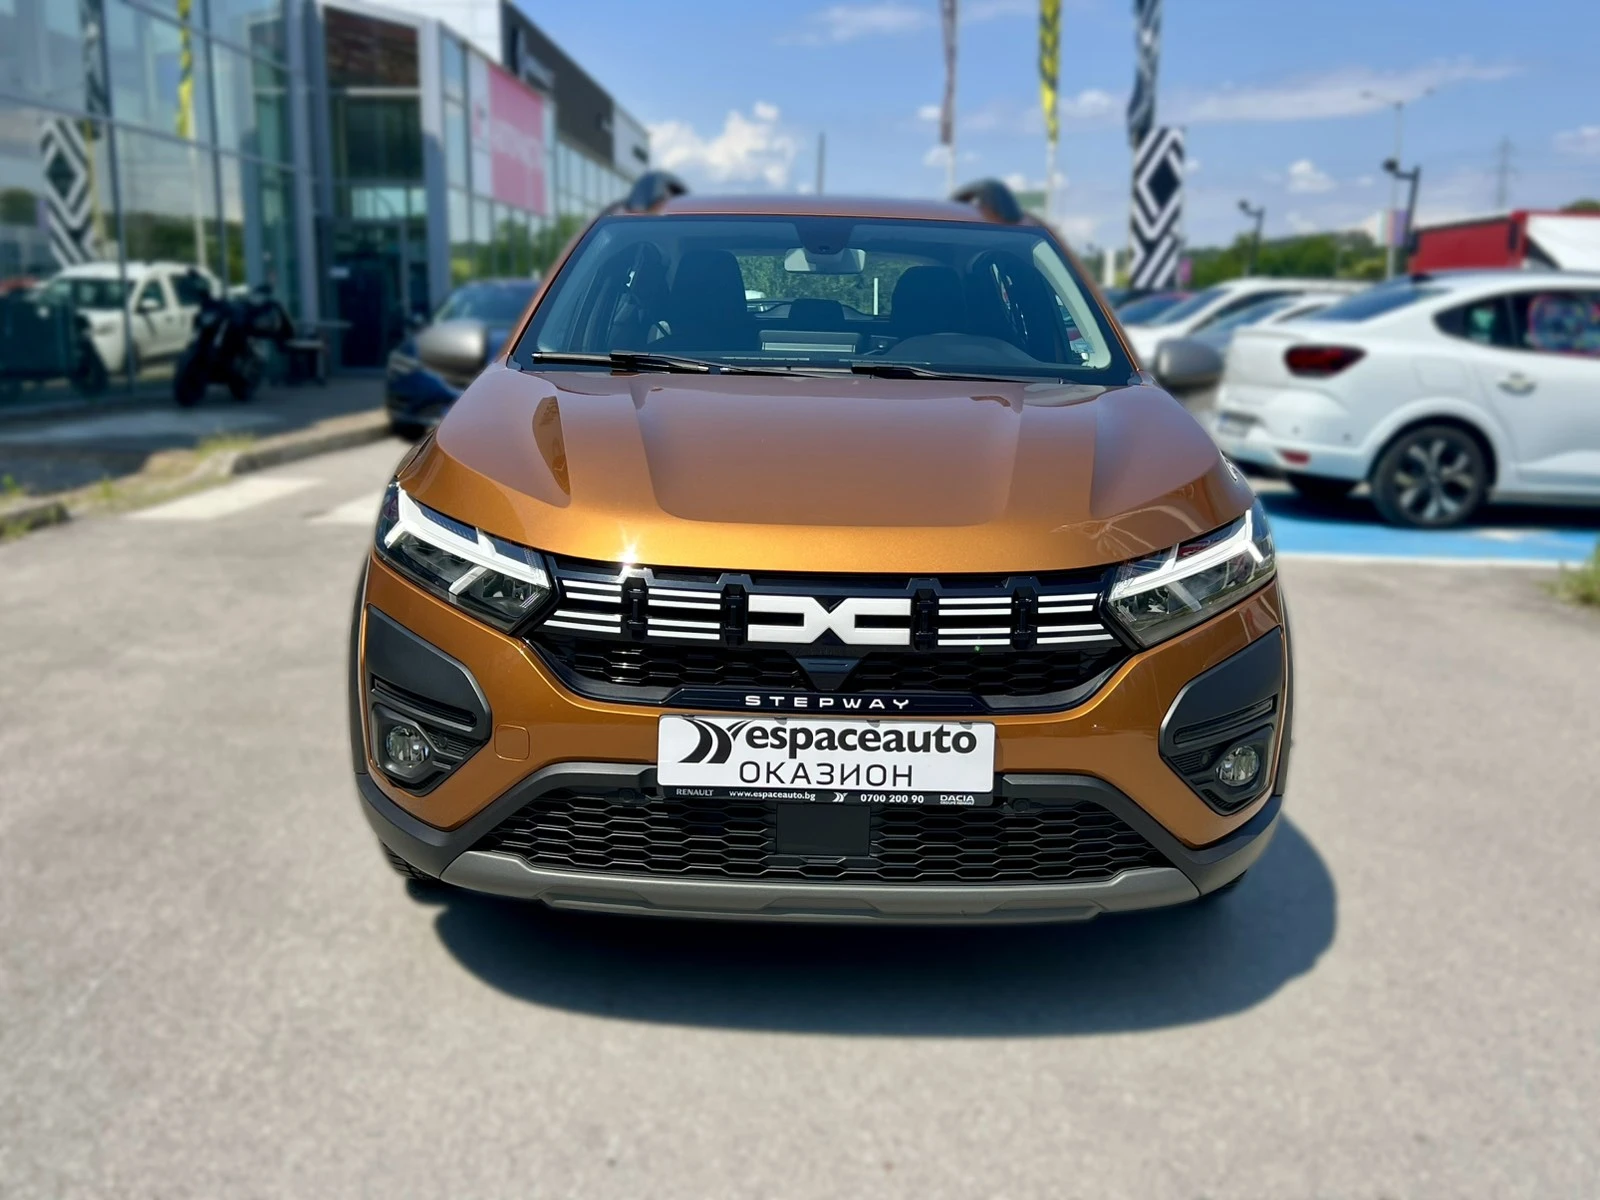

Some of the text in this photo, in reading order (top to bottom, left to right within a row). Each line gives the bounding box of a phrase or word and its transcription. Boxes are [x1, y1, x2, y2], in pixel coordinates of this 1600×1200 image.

[745, 695, 909, 710] STEPWAY
[745, 724, 977, 759] espaceauto
[739, 761, 913, 787] ОКАЗИОН
[676, 788, 714, 797] RENAULT
[729, 789, 816, 801] www.espaceauto.bg
[860, 793, 924, 804] 0700 200 90
[940, 794, 974, 802] DACIA
